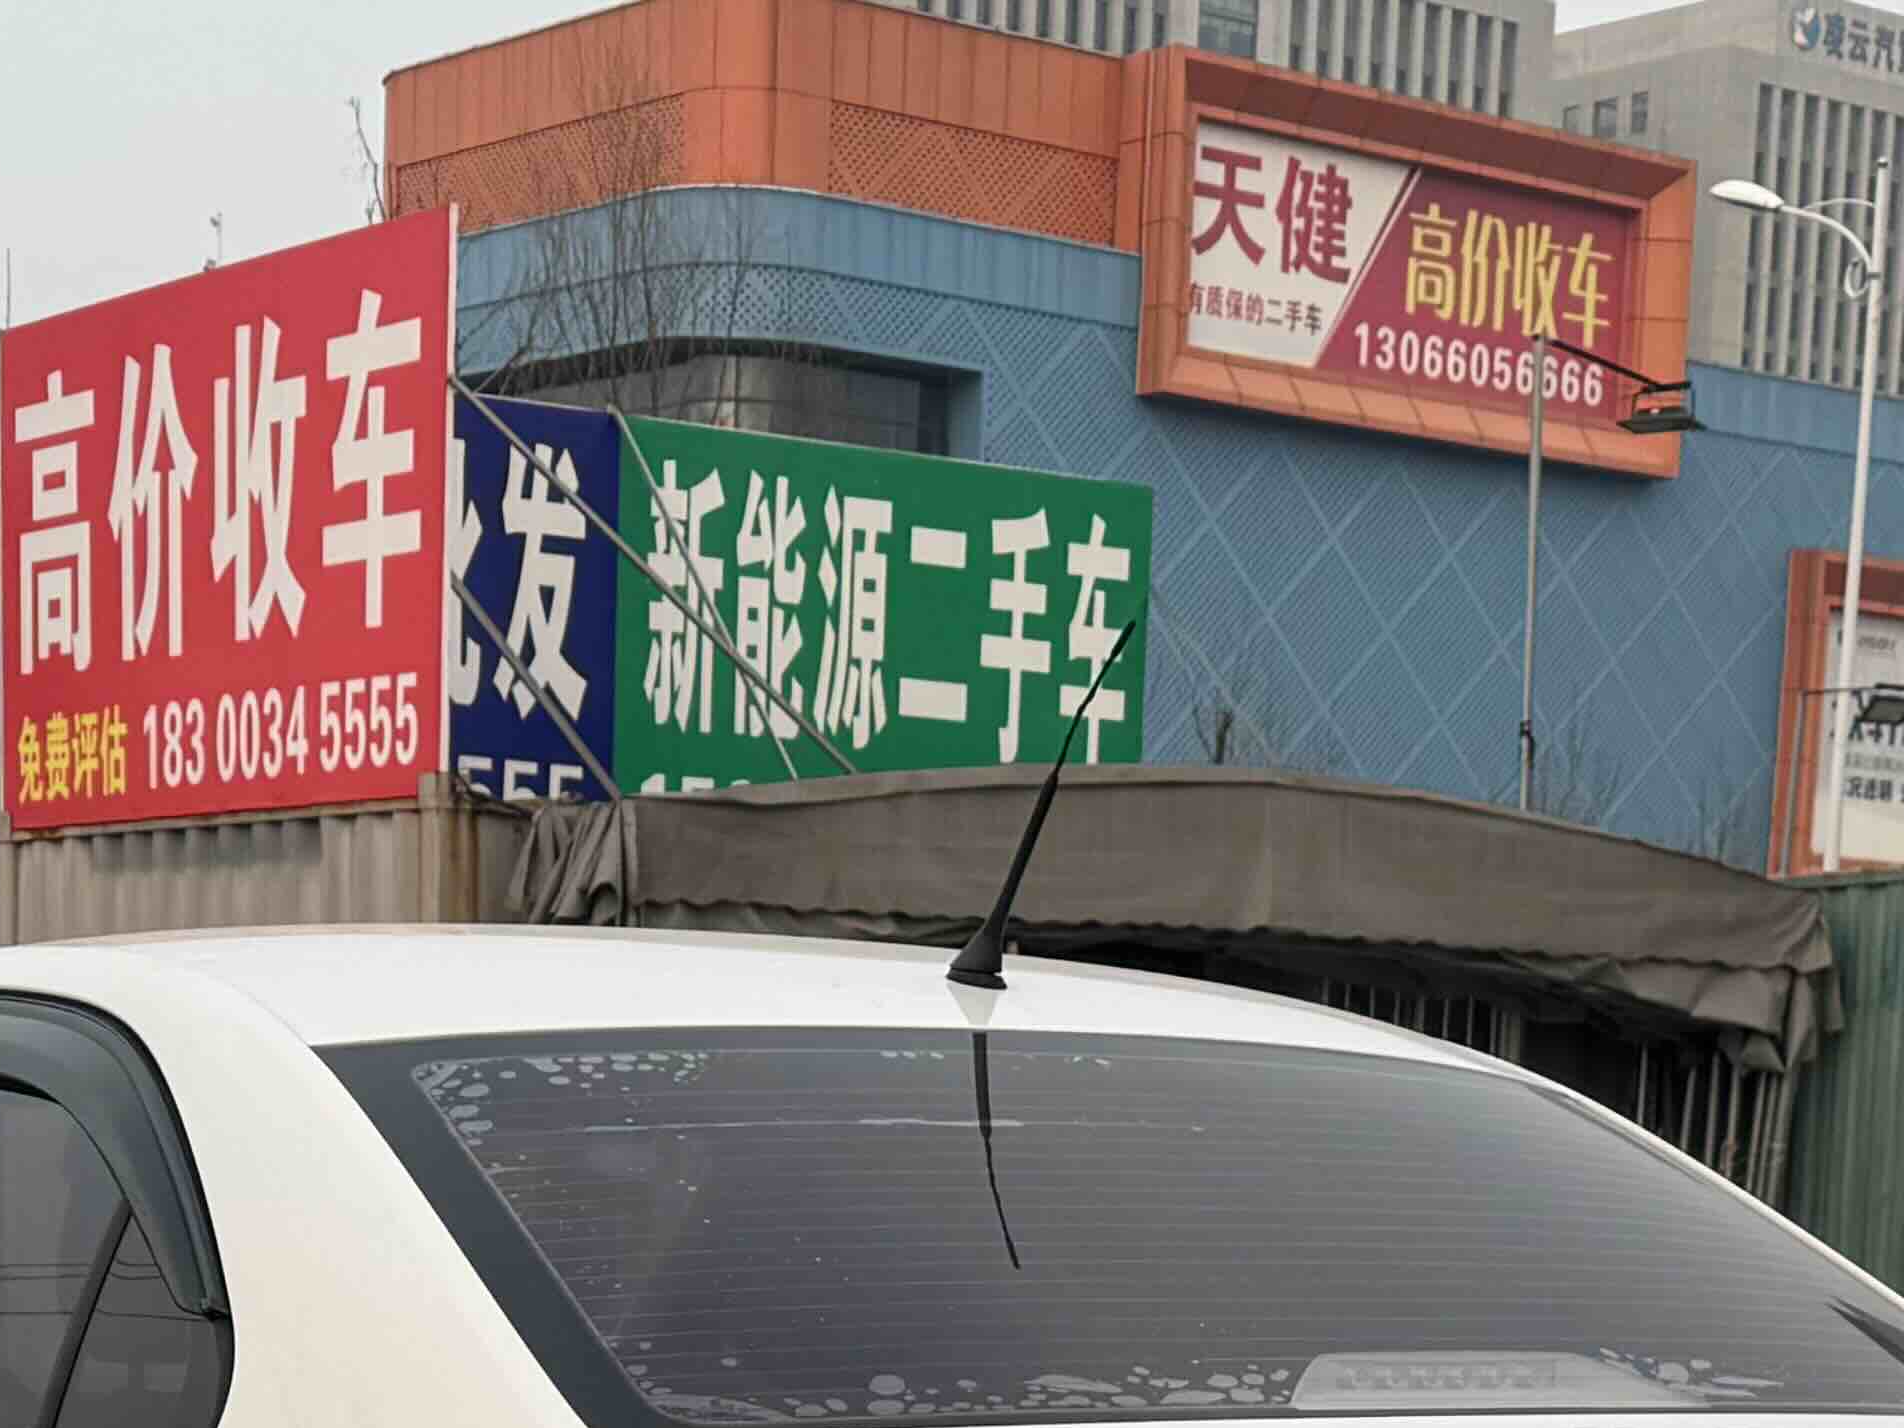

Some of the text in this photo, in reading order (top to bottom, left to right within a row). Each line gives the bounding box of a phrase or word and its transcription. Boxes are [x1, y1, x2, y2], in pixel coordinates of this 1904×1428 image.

[1192, 145, 1354, 284] 天健
[1405, 203, 1616, 348] 高价收车
[13, 288, 422, 677] 高价收车
[641, 458, 1132, 766] 新能源二手车
[17, 672, 419, 803] 免费评估 183 0034 5555
